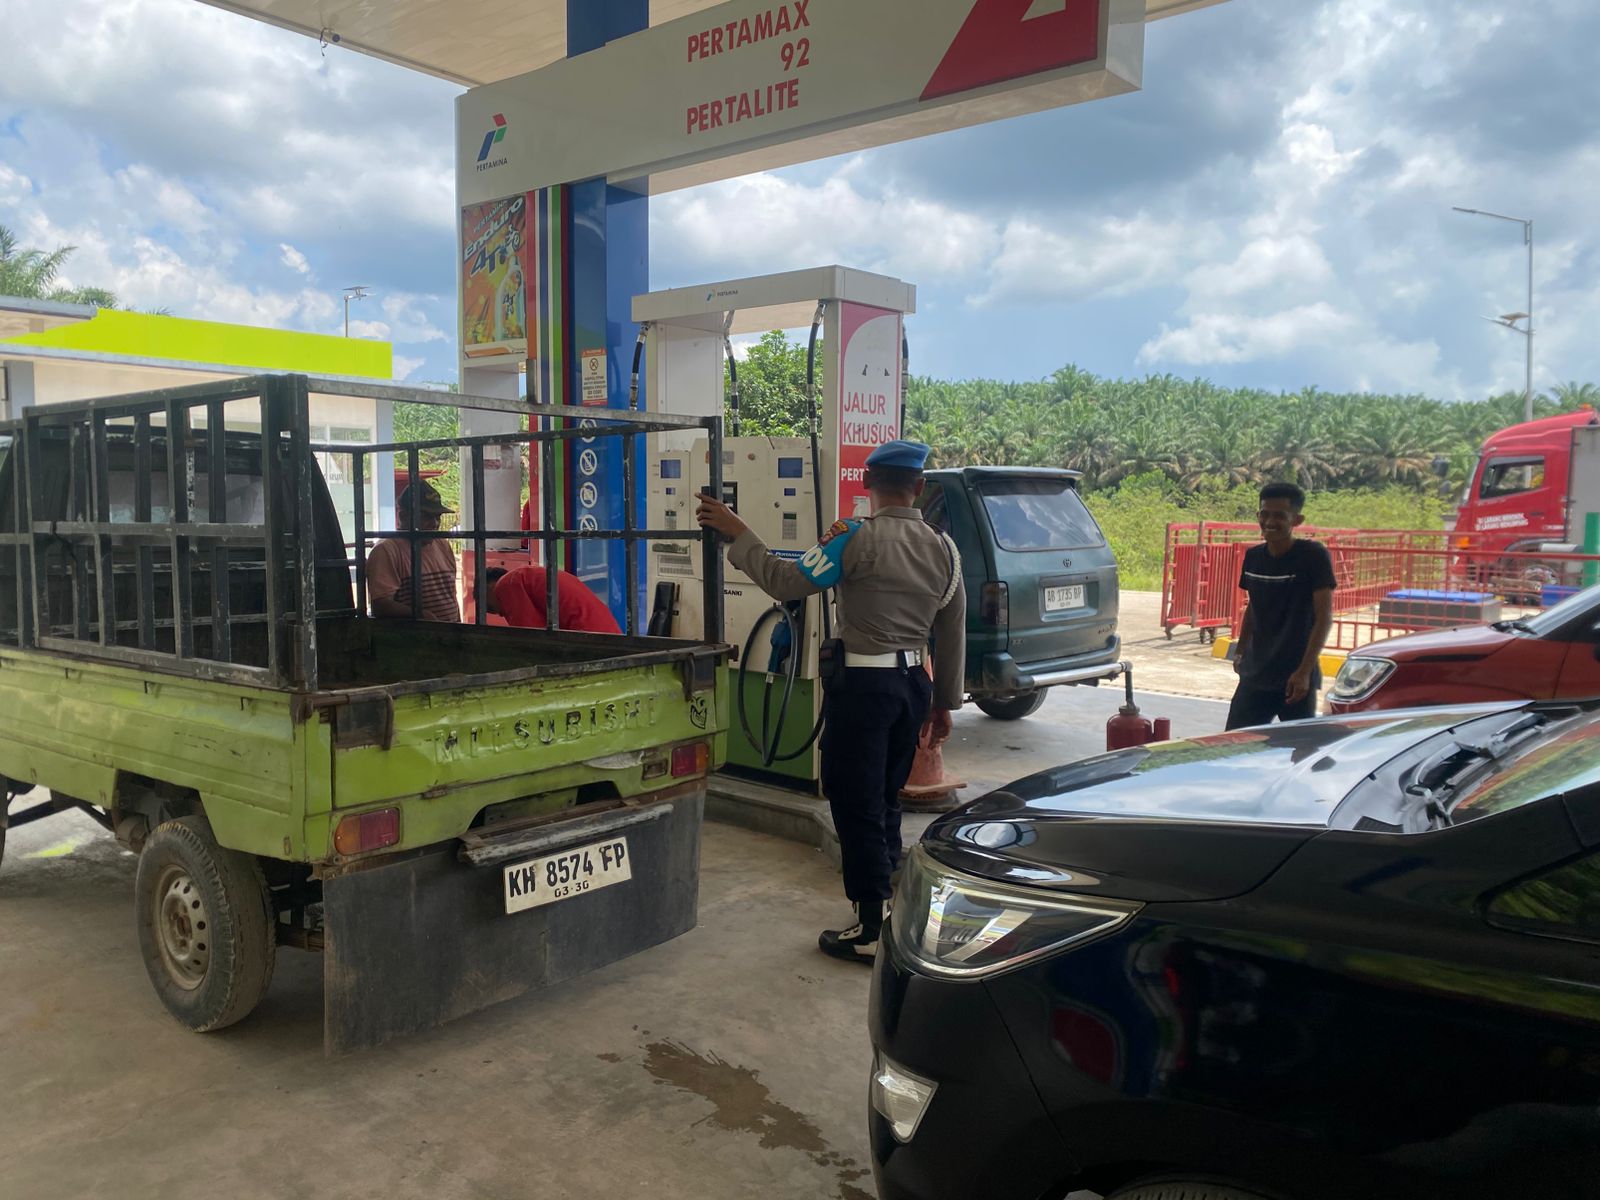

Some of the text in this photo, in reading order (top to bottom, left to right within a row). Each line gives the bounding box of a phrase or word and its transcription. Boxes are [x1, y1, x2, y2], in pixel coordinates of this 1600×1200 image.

[687, 0, 810, 63] PERTAMAX
[780, 37, 810, 71] 92
[686, 78, 799, 135] PERTALITE
[476, 157, 508, 172] PERTAMINA
[844, 392, 886, 415] JALUR
[843, 422, 895, 444] KHUSUS
[841, 468, 869, 481] PERT
[508, 842, 625, 898] KH 8574 FP
